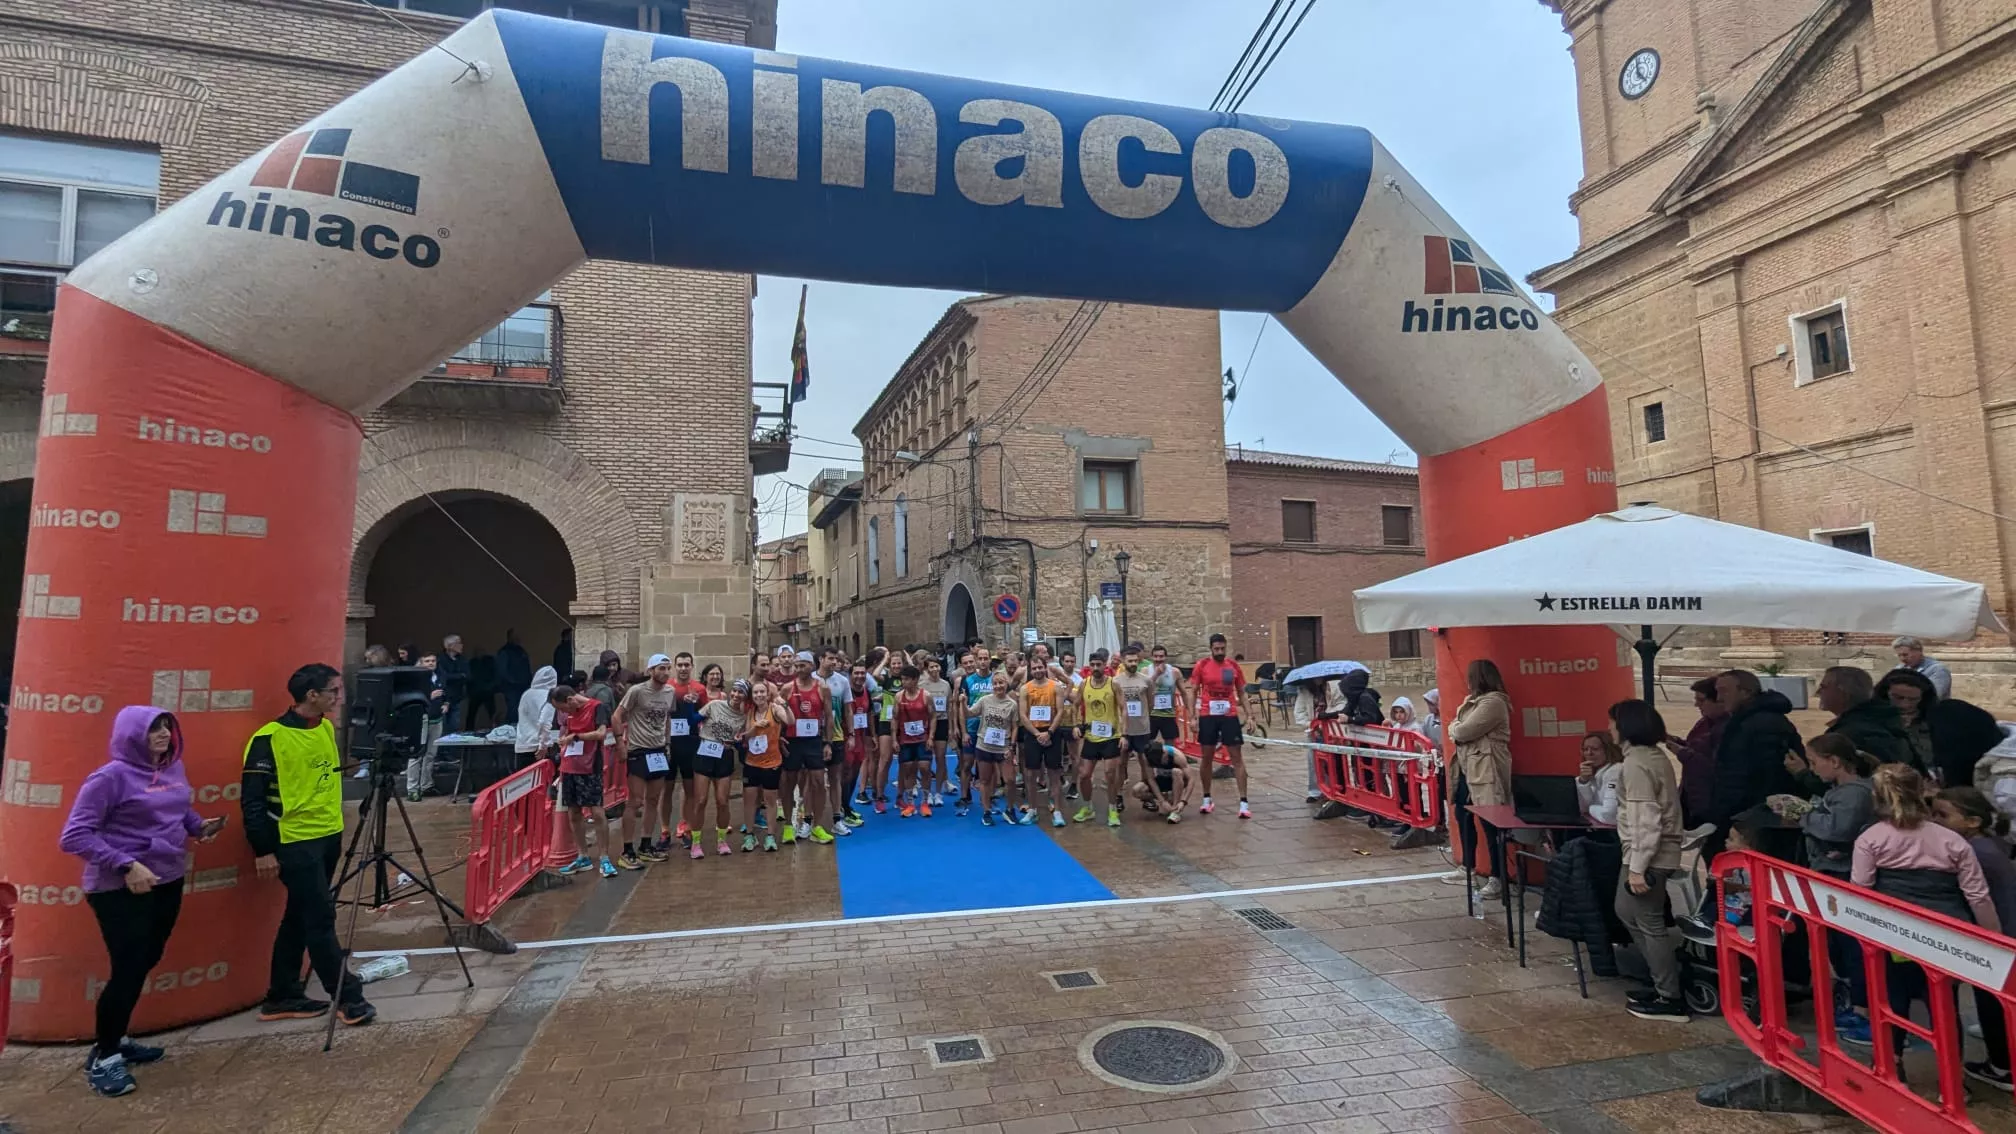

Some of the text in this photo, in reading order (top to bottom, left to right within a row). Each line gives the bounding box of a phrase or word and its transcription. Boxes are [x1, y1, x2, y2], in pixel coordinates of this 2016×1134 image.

[600, 31, 1290, 229] hinaco
[341, 190, 414, 213] Constructora
[1402, 298, 1539, 333] hinaco
[138, 416, 273, 453] hinaco
[32, 504, 121, 530] hinaco
[122, 597, 260, 625] hinaco
[1560, 596, 1702, 611] ESTRELLA DAMM
[1519, 656, 1600, 675] hinaco
[14, 686, 104, 714] hinaco
[673, 722, 684, 730] 71
[1844, 906, 1898, 934] AYUNTAMIENTO
[1899, 926, 1910, 938] DE
[1911, 931, 1950, 953] ALCOLEA
